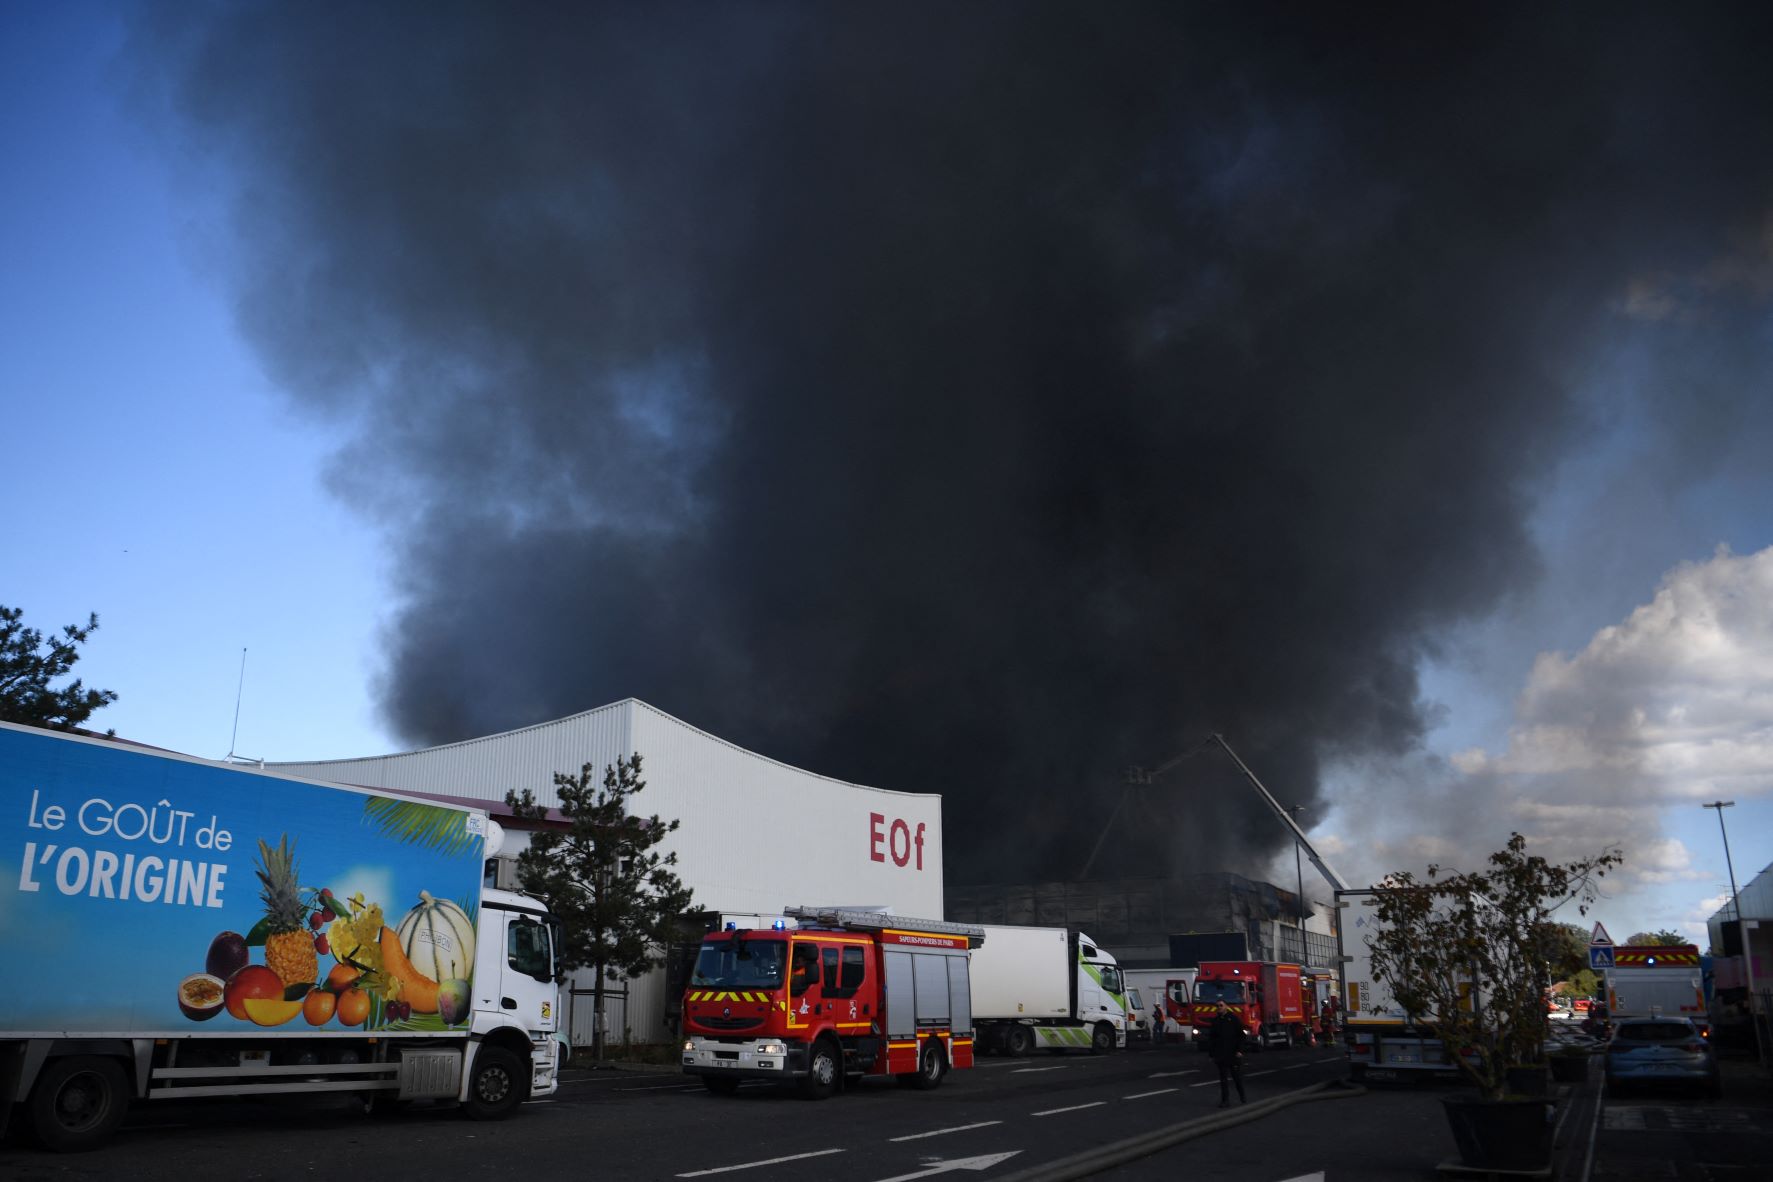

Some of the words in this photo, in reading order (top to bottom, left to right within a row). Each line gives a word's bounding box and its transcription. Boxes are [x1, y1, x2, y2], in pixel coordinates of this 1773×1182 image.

[28, 789, 66, 831] Le
[78, 798, 195, 847] GOÛT
[195, 815, 233, 851] de
[18, 842, 228, 909] L'ORIGINE
